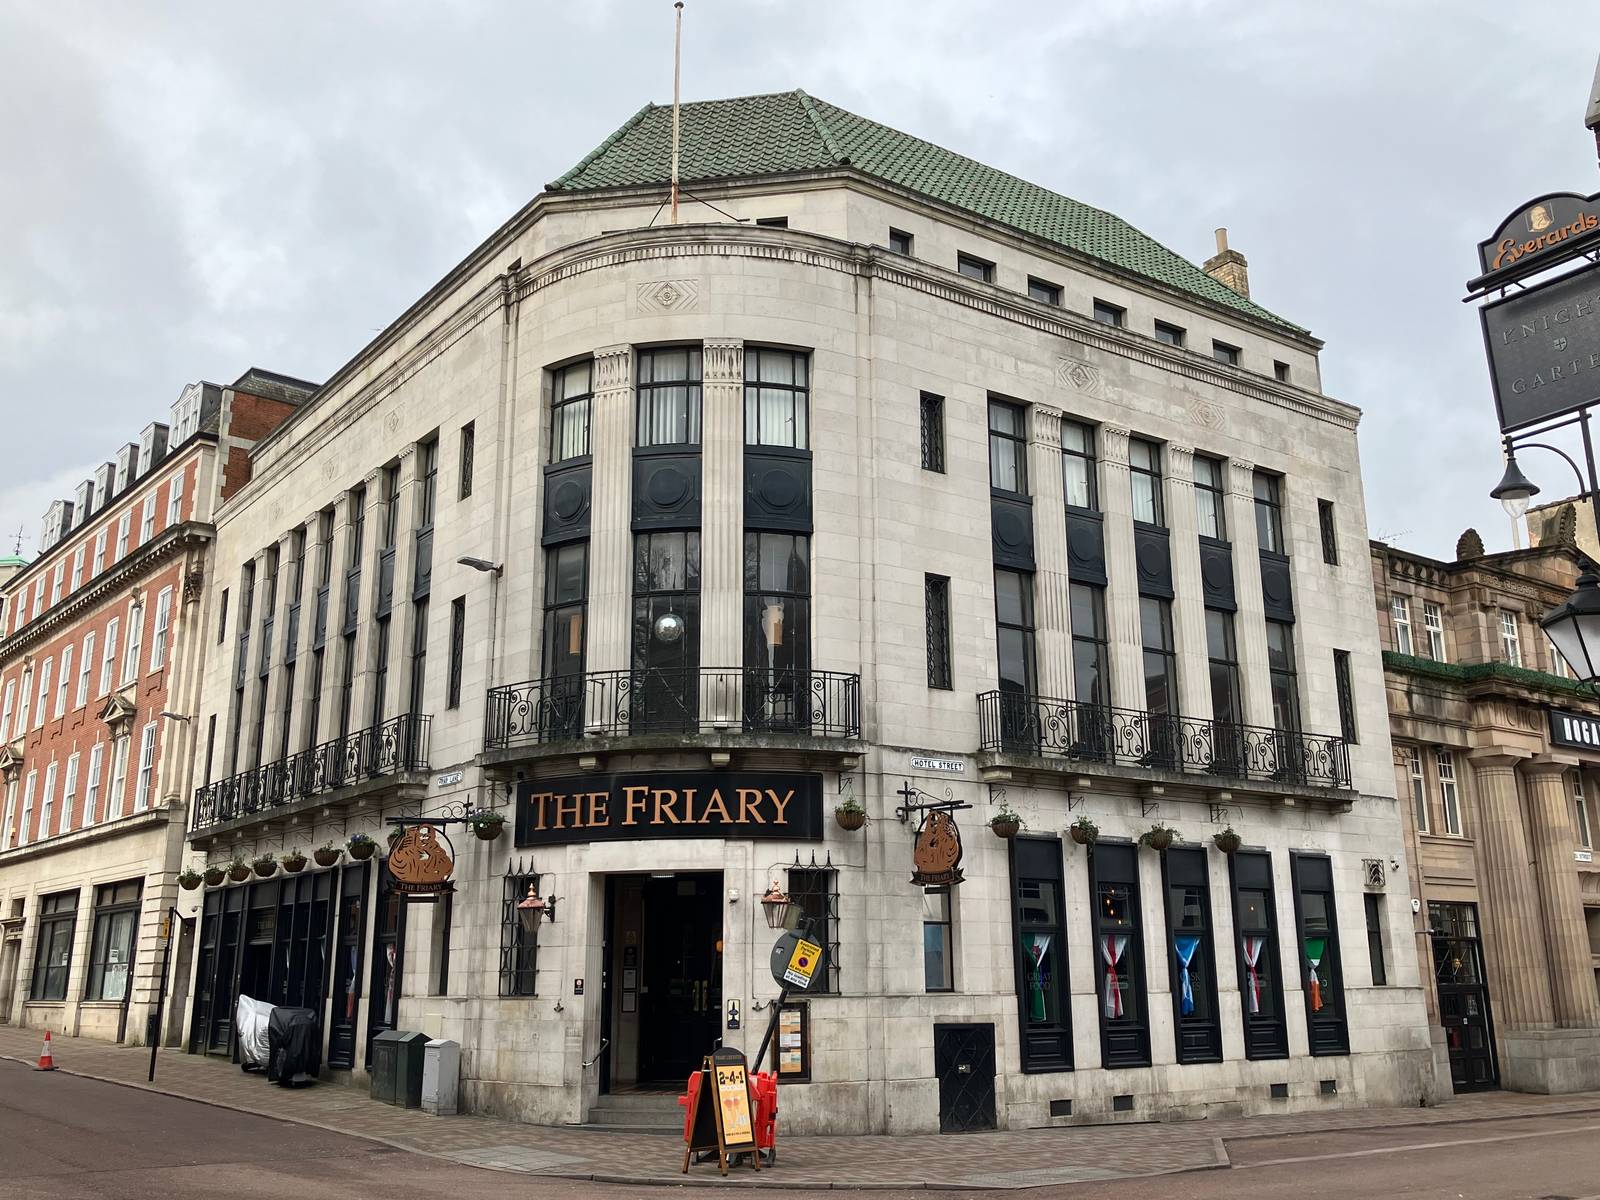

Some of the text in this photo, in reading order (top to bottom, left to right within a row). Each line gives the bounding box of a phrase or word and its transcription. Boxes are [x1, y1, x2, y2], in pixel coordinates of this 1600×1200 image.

[1492, 212, 1599, 270] Everards
[1503, 296, 1600, 346] KNIGH
[1563, 717, 1600, 746] HOGA
[914, 760, 962, 770] HOTEL STREET
[530, 786, 795, 831] THE FRIARY
[400, 882, 443, 892] THE FRIARY
[718, 1070, 744, 1085] 2-4-1
